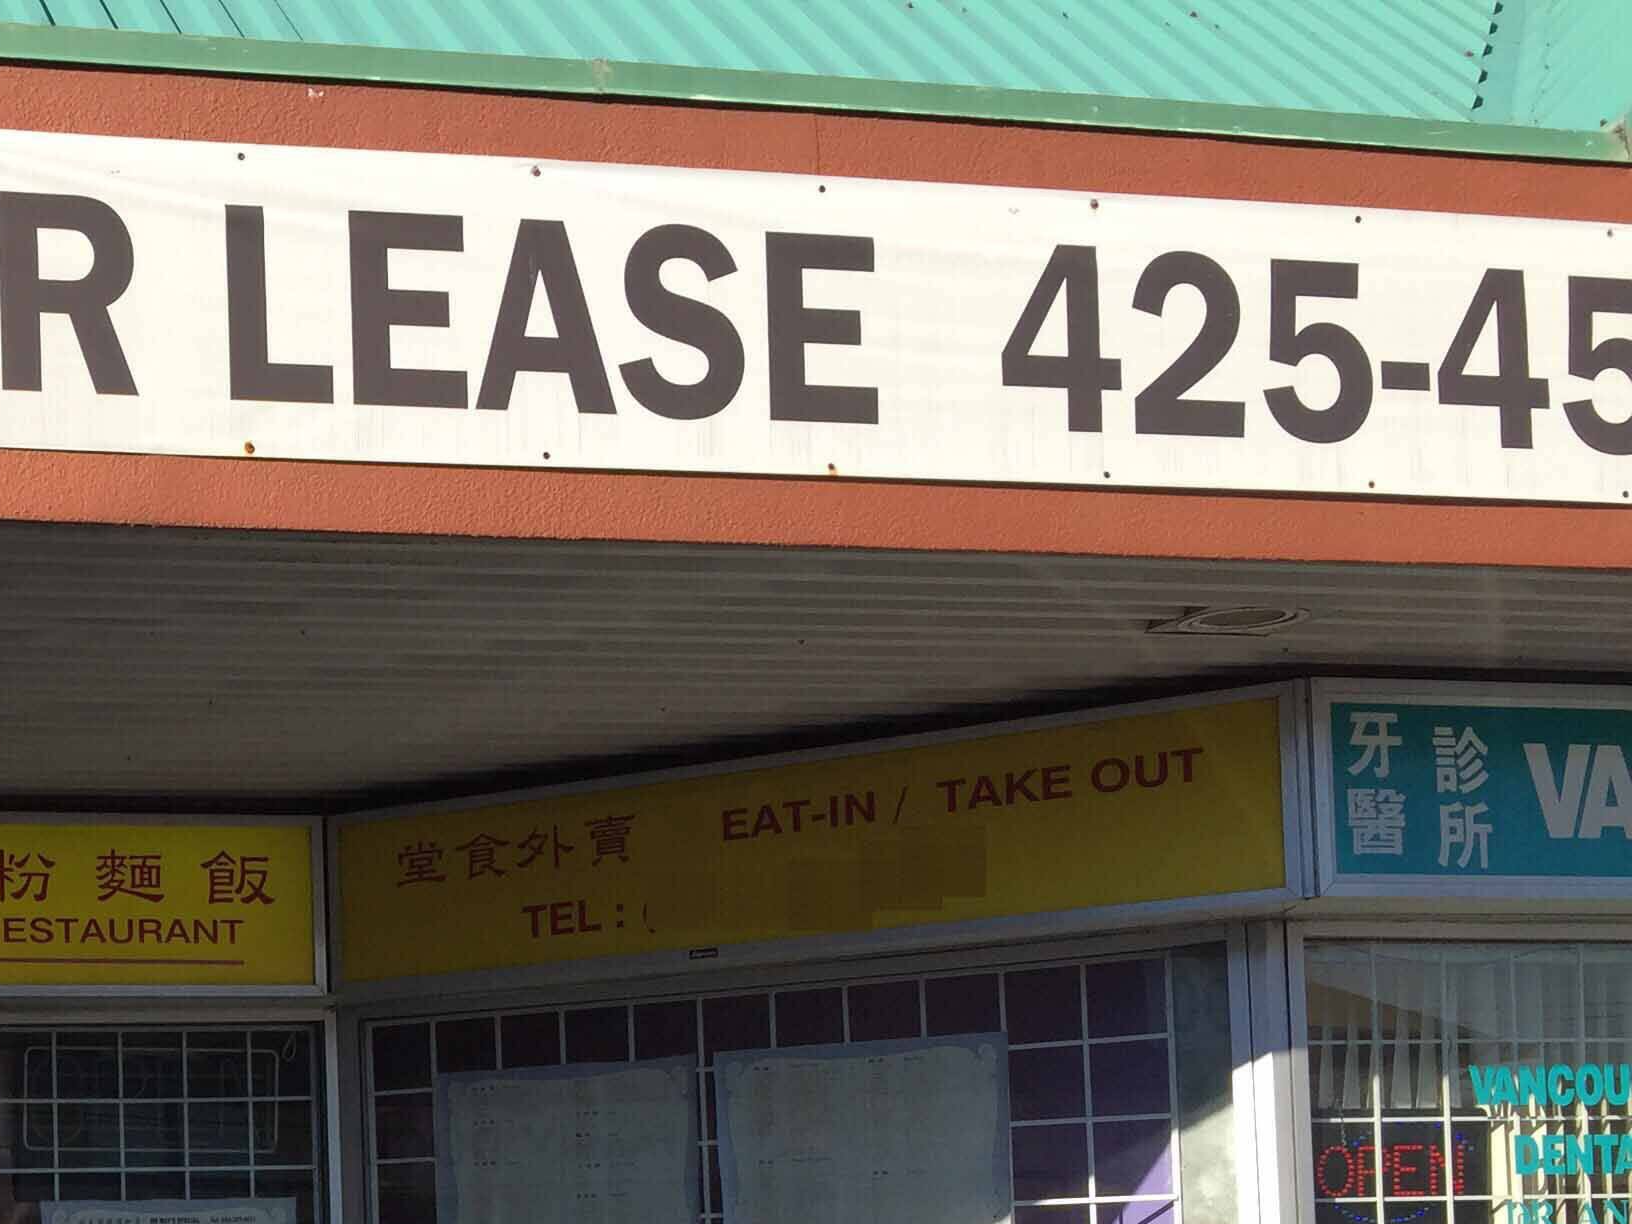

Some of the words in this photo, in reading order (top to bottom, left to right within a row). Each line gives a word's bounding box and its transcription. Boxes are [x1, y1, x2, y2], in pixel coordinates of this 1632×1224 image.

[224, 204, 880, 425] LEASE
[1001, 243, 1632, 456] 425-45
[721, 789, 877, 842] EAT-IN
[937, 765, 1073, 815] TAKE
[1090, 747, 1204, 792] OUT
[1346, 712, 1407, 855] 牙醫
[1431, 726, 1493, 869] 診所
[1522, 743, 1632, 839] VA
[396, 813, 634, 888] 堂食外賣
[1468, 1063, 1631, 1106] VANCOU
[1317, 1144, 1465, 1197] OPEN
